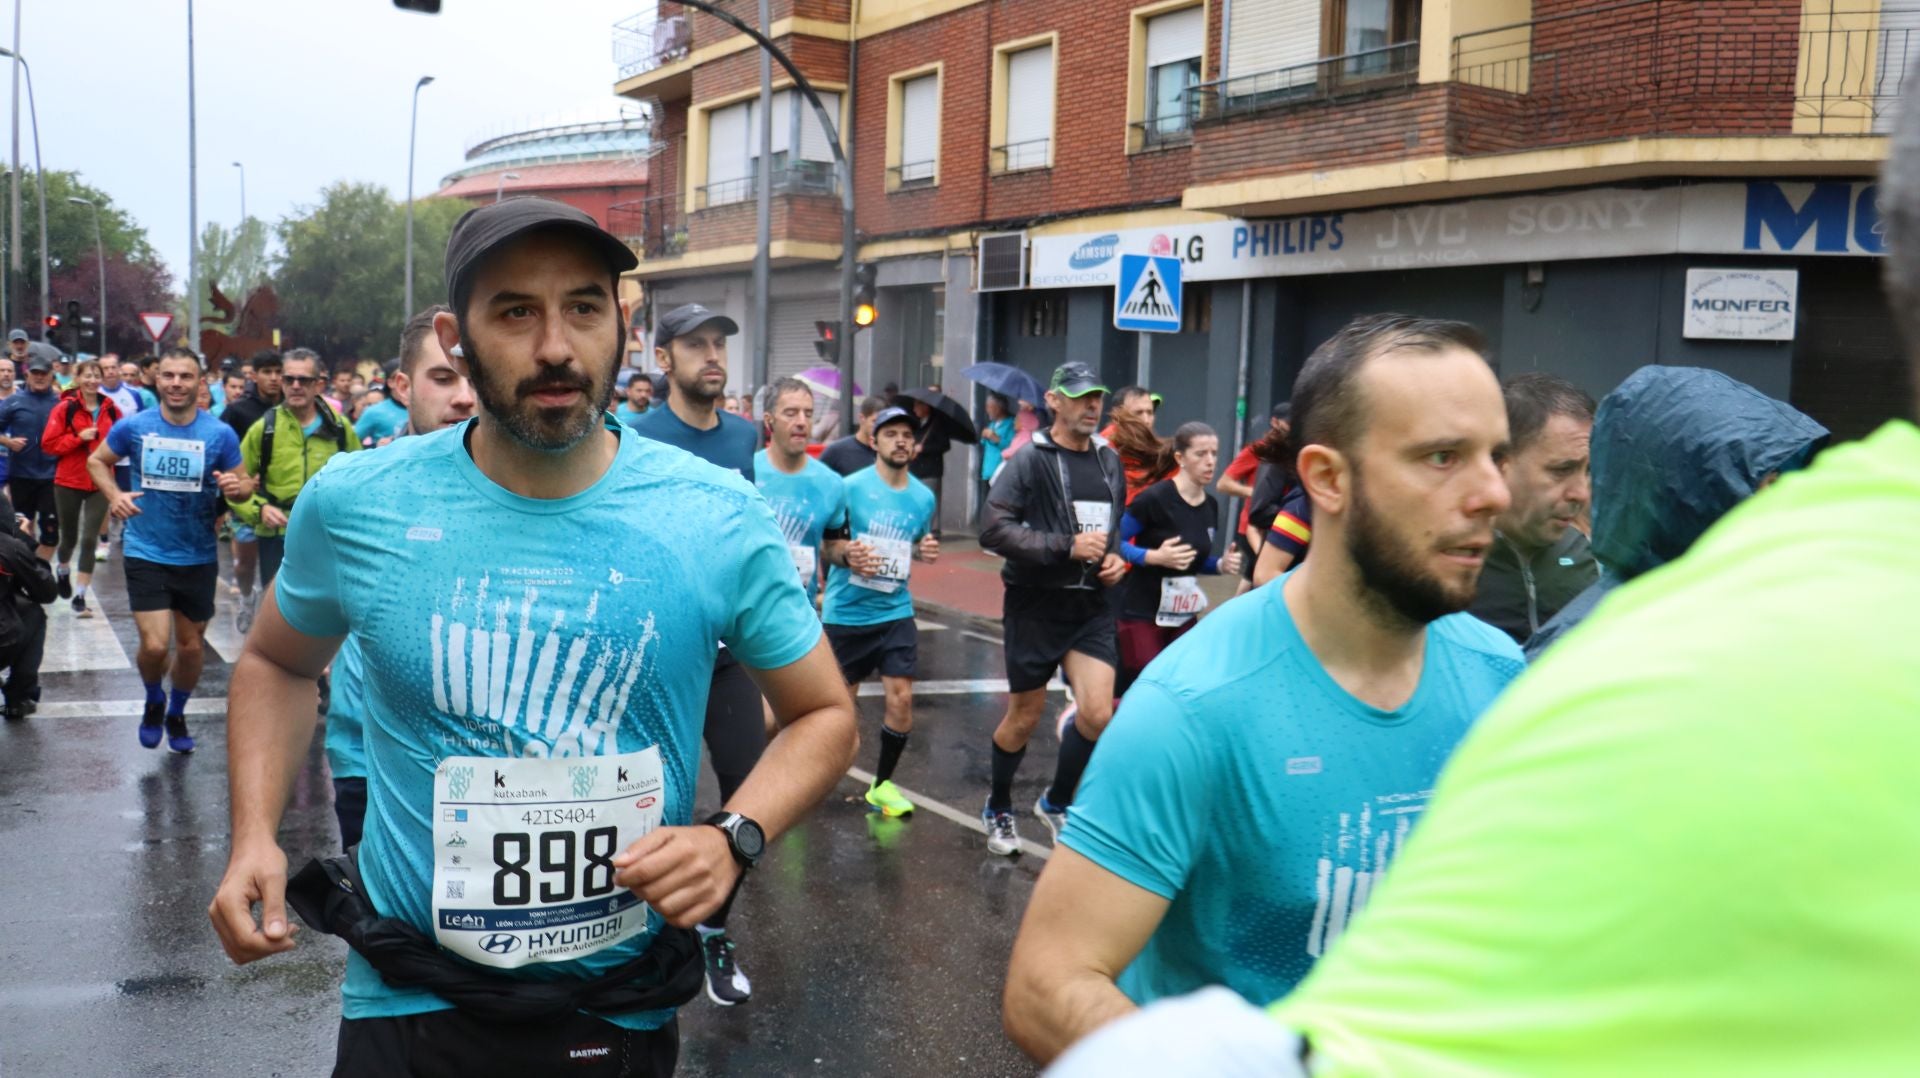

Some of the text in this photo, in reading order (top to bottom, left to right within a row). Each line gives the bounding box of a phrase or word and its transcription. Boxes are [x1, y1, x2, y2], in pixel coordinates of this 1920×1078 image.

[1506, 197, 1658, 236] SONY
[1232, 214, 1344, 259] PHILIPS
[1376, 207, 1468, 248] JVC
[1075, 245, 1116, 259] SAMSUN
[1172, 235, 1203, 263] LG
[1034, 273, 1108, 286] SERVICIO
[1692, 299, 1791, 312] MONFER
[156, 456, 189, 476] 489
[879, 556, 898, 576] 54
[1172, 594, 1198, 612] 1147
[493, 789, 547, 799] kutxabank
[616, 776, 658, 793] kutxabank
[493, 826, 618, 906] 898
[529, 915, 622, 949] HYUNDAI
[569, 1048, 608, 1058] EASTPAK
